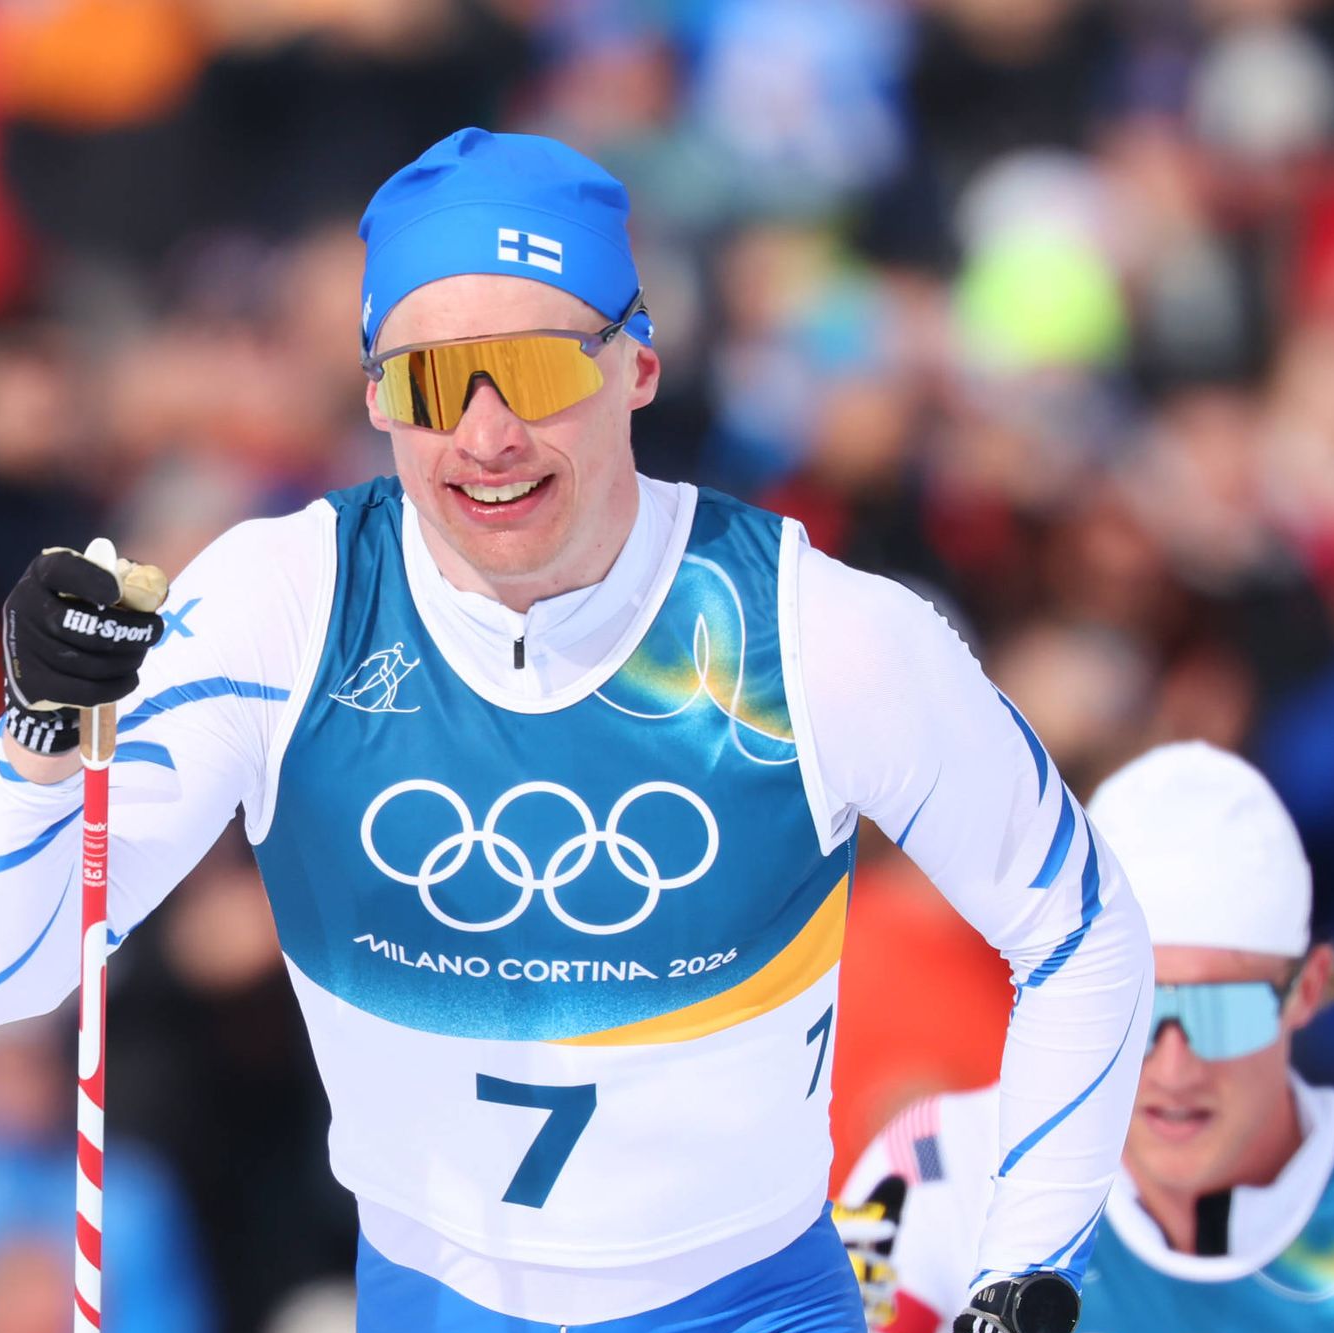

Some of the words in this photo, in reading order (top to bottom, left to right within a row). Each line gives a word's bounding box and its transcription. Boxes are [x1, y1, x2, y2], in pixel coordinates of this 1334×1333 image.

[353, 933, 491, 978] MILANO
[497, 958, 659, 982] CORTINA
[667, 947, 738, 978] 2026
[805, 1003, 833, 1101] 7
[475, 1072, 597, 1209] 7
